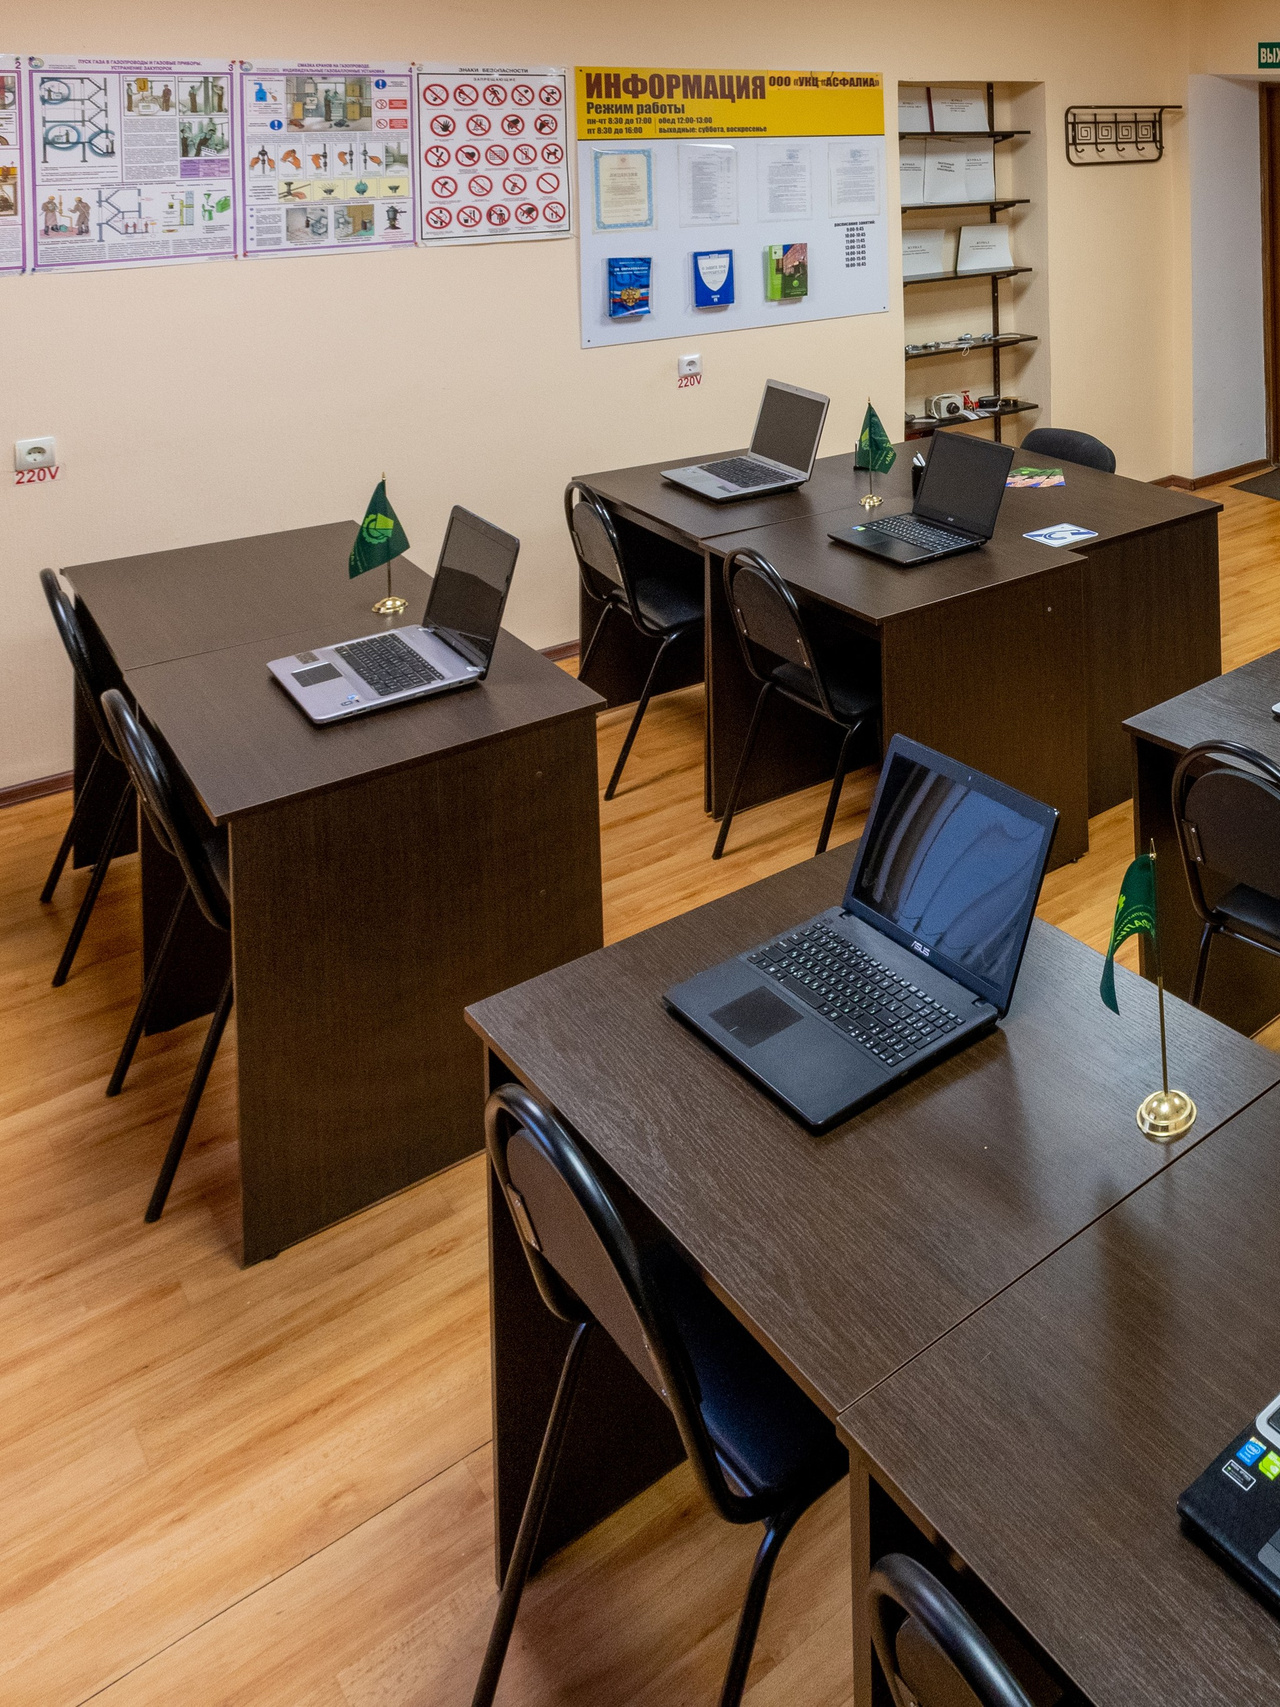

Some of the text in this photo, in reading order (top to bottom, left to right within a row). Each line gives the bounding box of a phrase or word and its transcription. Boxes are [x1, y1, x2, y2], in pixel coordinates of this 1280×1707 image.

[586, 72, 766, 103] ИНФОРМАЦИЯ
[768, 76, 791, 87] ООО
[821, 76, 880, 88] «АСФАЛИА»
[586, 102, 686, 115] Режим работы
[608, 117, 623, 125] 8:30
[624, 117, 634, 125] до
[635, 117, 652, 125] 17:00
[658, 116, 713, 125] обед 12:00-13:00
[587, 126, 643, 135] пт 8:30 до 16:00
[658, 126, 698, 134] выходные:
[698, 126, 726, 134] суббота,
[677, 374, 702, 389] 220V
[15, 466, 60, 485] 220V
[911, 940, 930, 957] ASUS
